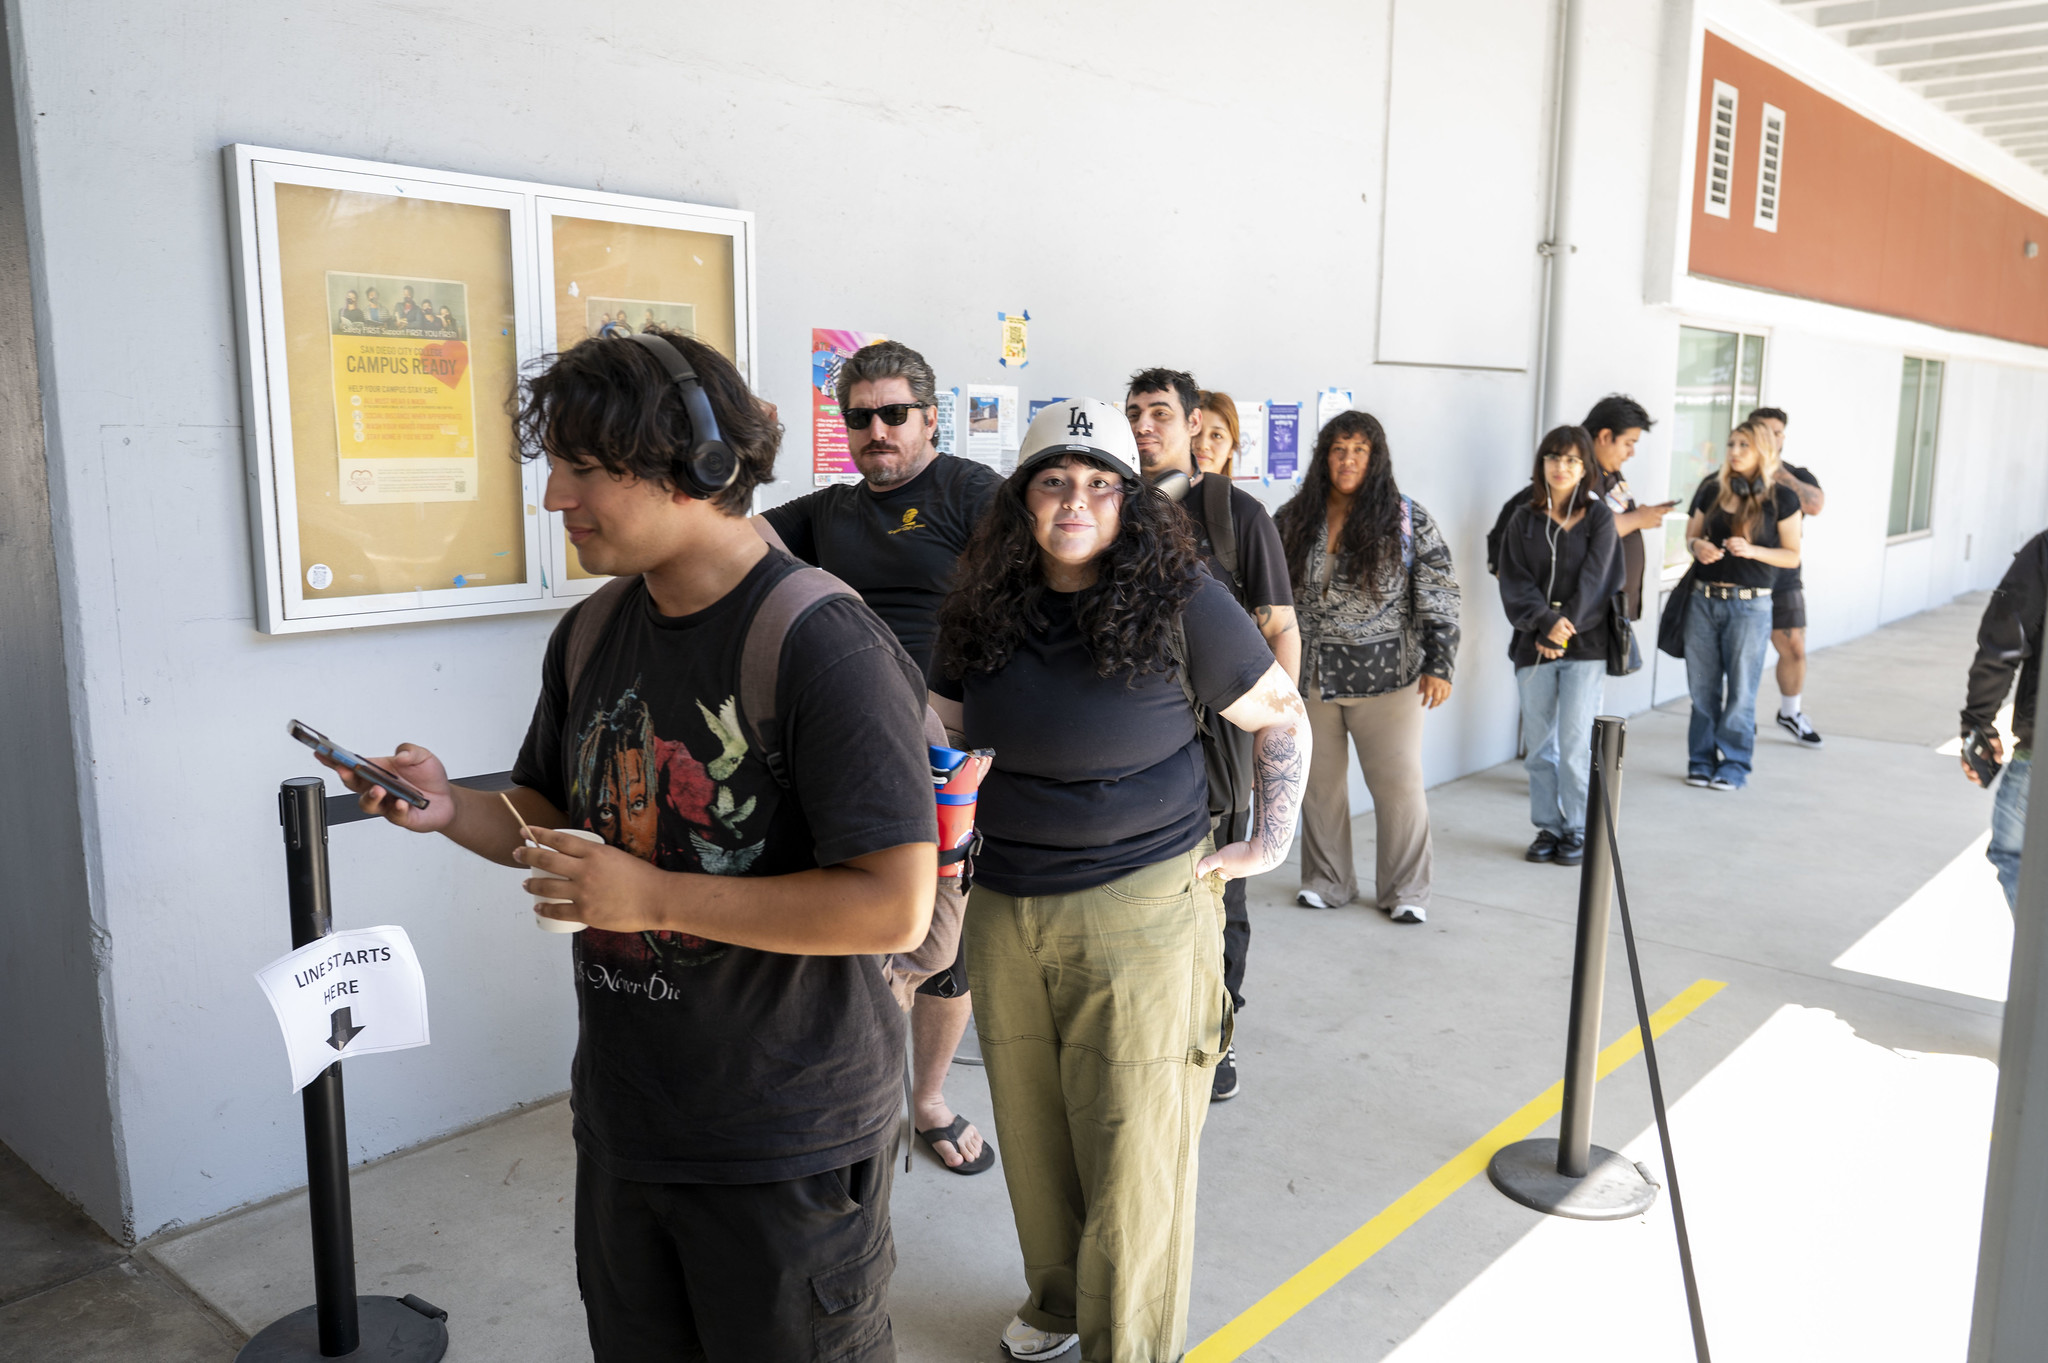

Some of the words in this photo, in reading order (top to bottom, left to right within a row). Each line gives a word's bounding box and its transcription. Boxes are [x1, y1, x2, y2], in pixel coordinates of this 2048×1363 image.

[360, 345, 374, 354] SAN
[376, 346, 396, 355] DIEGO
[398, 347, 413, 356] CITY
[414, 348, 442, 357] COLLEGE
[347, 355, 408, 375] CAMPUS
[413, 358, 457, 376] READY
[365, 385, 381, 393] YOUR
[408, 386, 422, 394] STAY
[424, 386, 438, 394] SAFE
[1067, 406, 1093, 437] LA
[294, 962, 326, 988] LINE
[327, 947, 391, 972] STARTS
[323, 979, 359, 1005] HERE
[587, 964, 641, 994] Never
[643, 970, 681, 1000] Die
